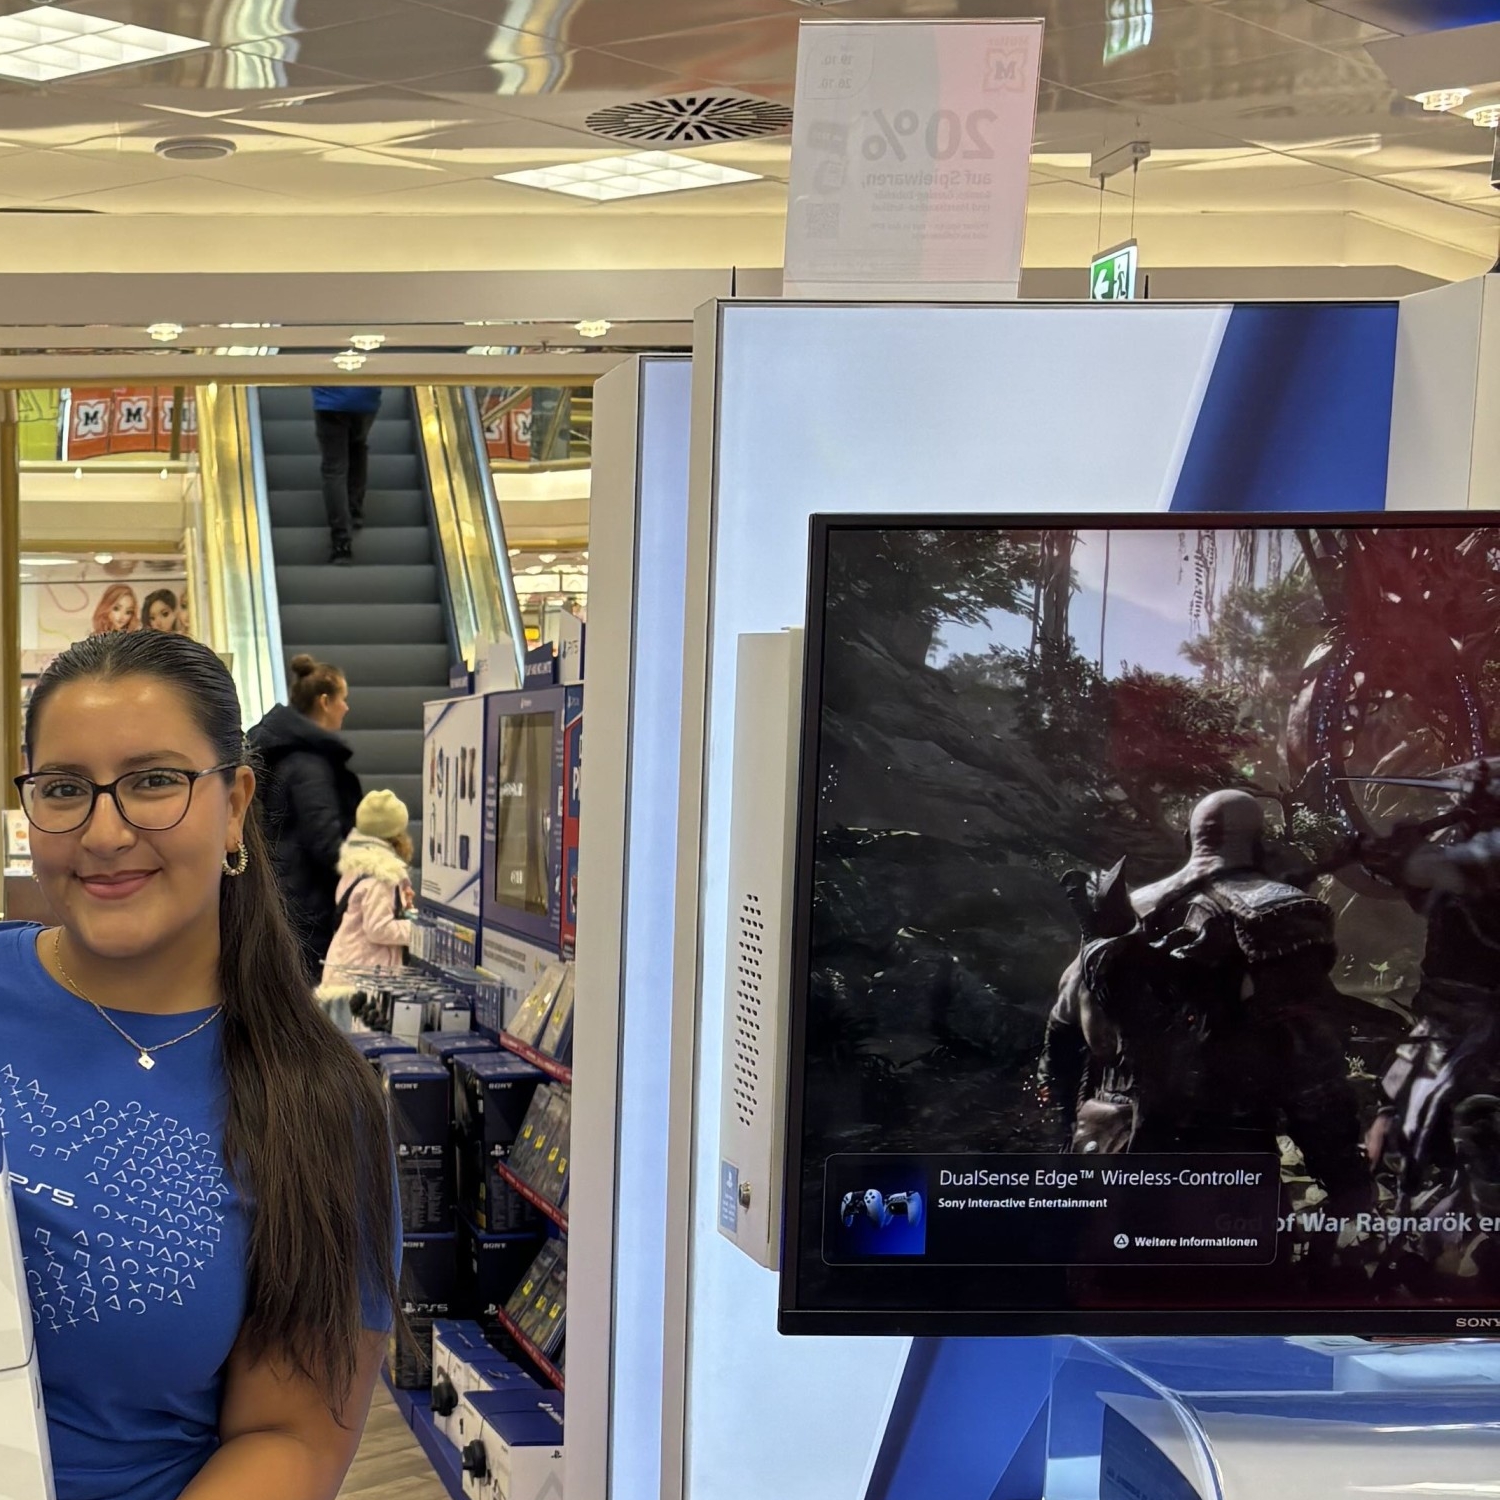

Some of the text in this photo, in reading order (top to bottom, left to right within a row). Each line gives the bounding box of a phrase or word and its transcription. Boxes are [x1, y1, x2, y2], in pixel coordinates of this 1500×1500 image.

[83, 410, 100, 426] M
[125, 407, 143, 423] M
[939, 1169, 1029, 1186] DualSense
[1101, 1169, 1262, 1186] Wireless-Controller
[8, 1172, 76, 1208] PS5
[938, 1197, 1108, 1210] Sony Interactive Entertainment
[1301, 1212, 1350, 1232] War
[1356, 1211, 1471, 1237] Ragnarök
[1135, 1236, 1258, 1247] Weitere Informationen
[1456, 1317, 1500, 1328] SONY
